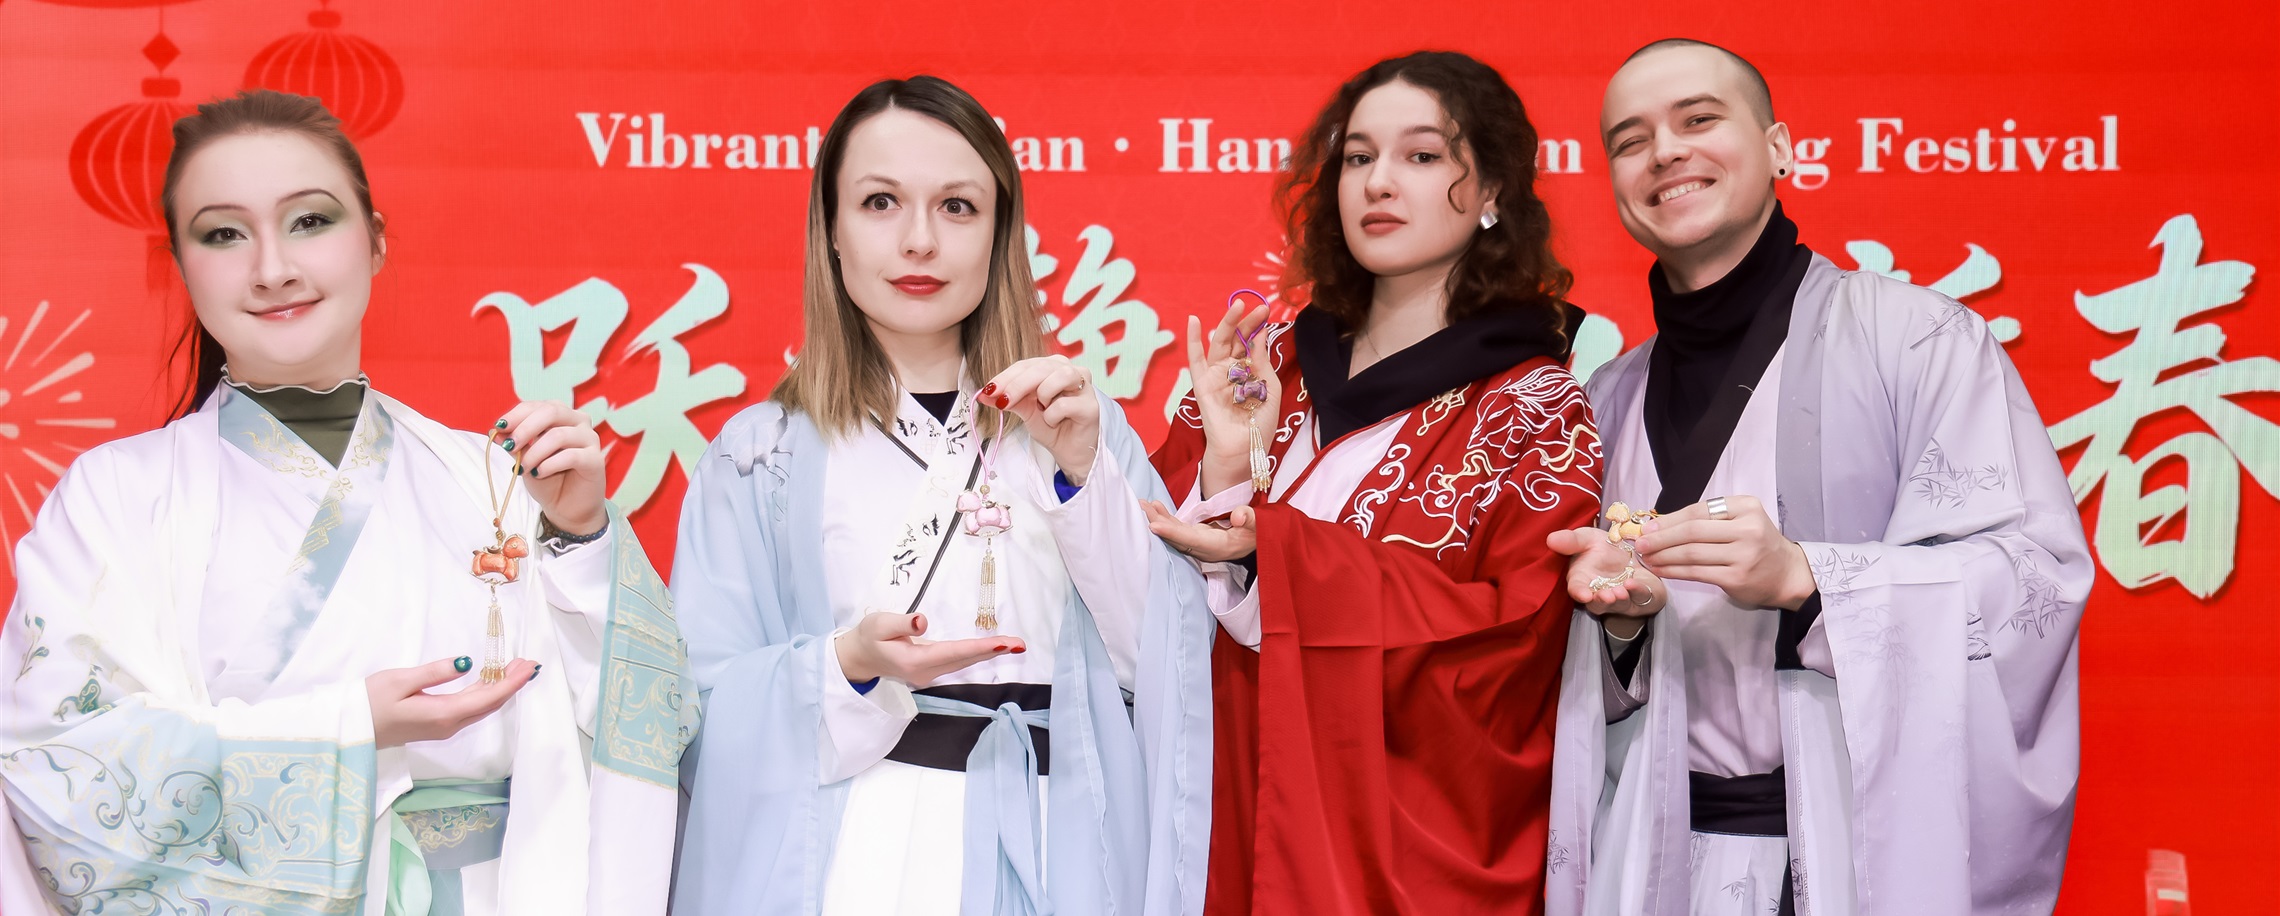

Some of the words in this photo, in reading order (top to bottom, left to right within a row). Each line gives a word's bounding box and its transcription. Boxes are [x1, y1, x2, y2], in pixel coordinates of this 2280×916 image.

[576, 112, 824, 170] Vibrant
[1158, 117, 1292, 173] Han
[1857, 115, 2122, 174] Festival
